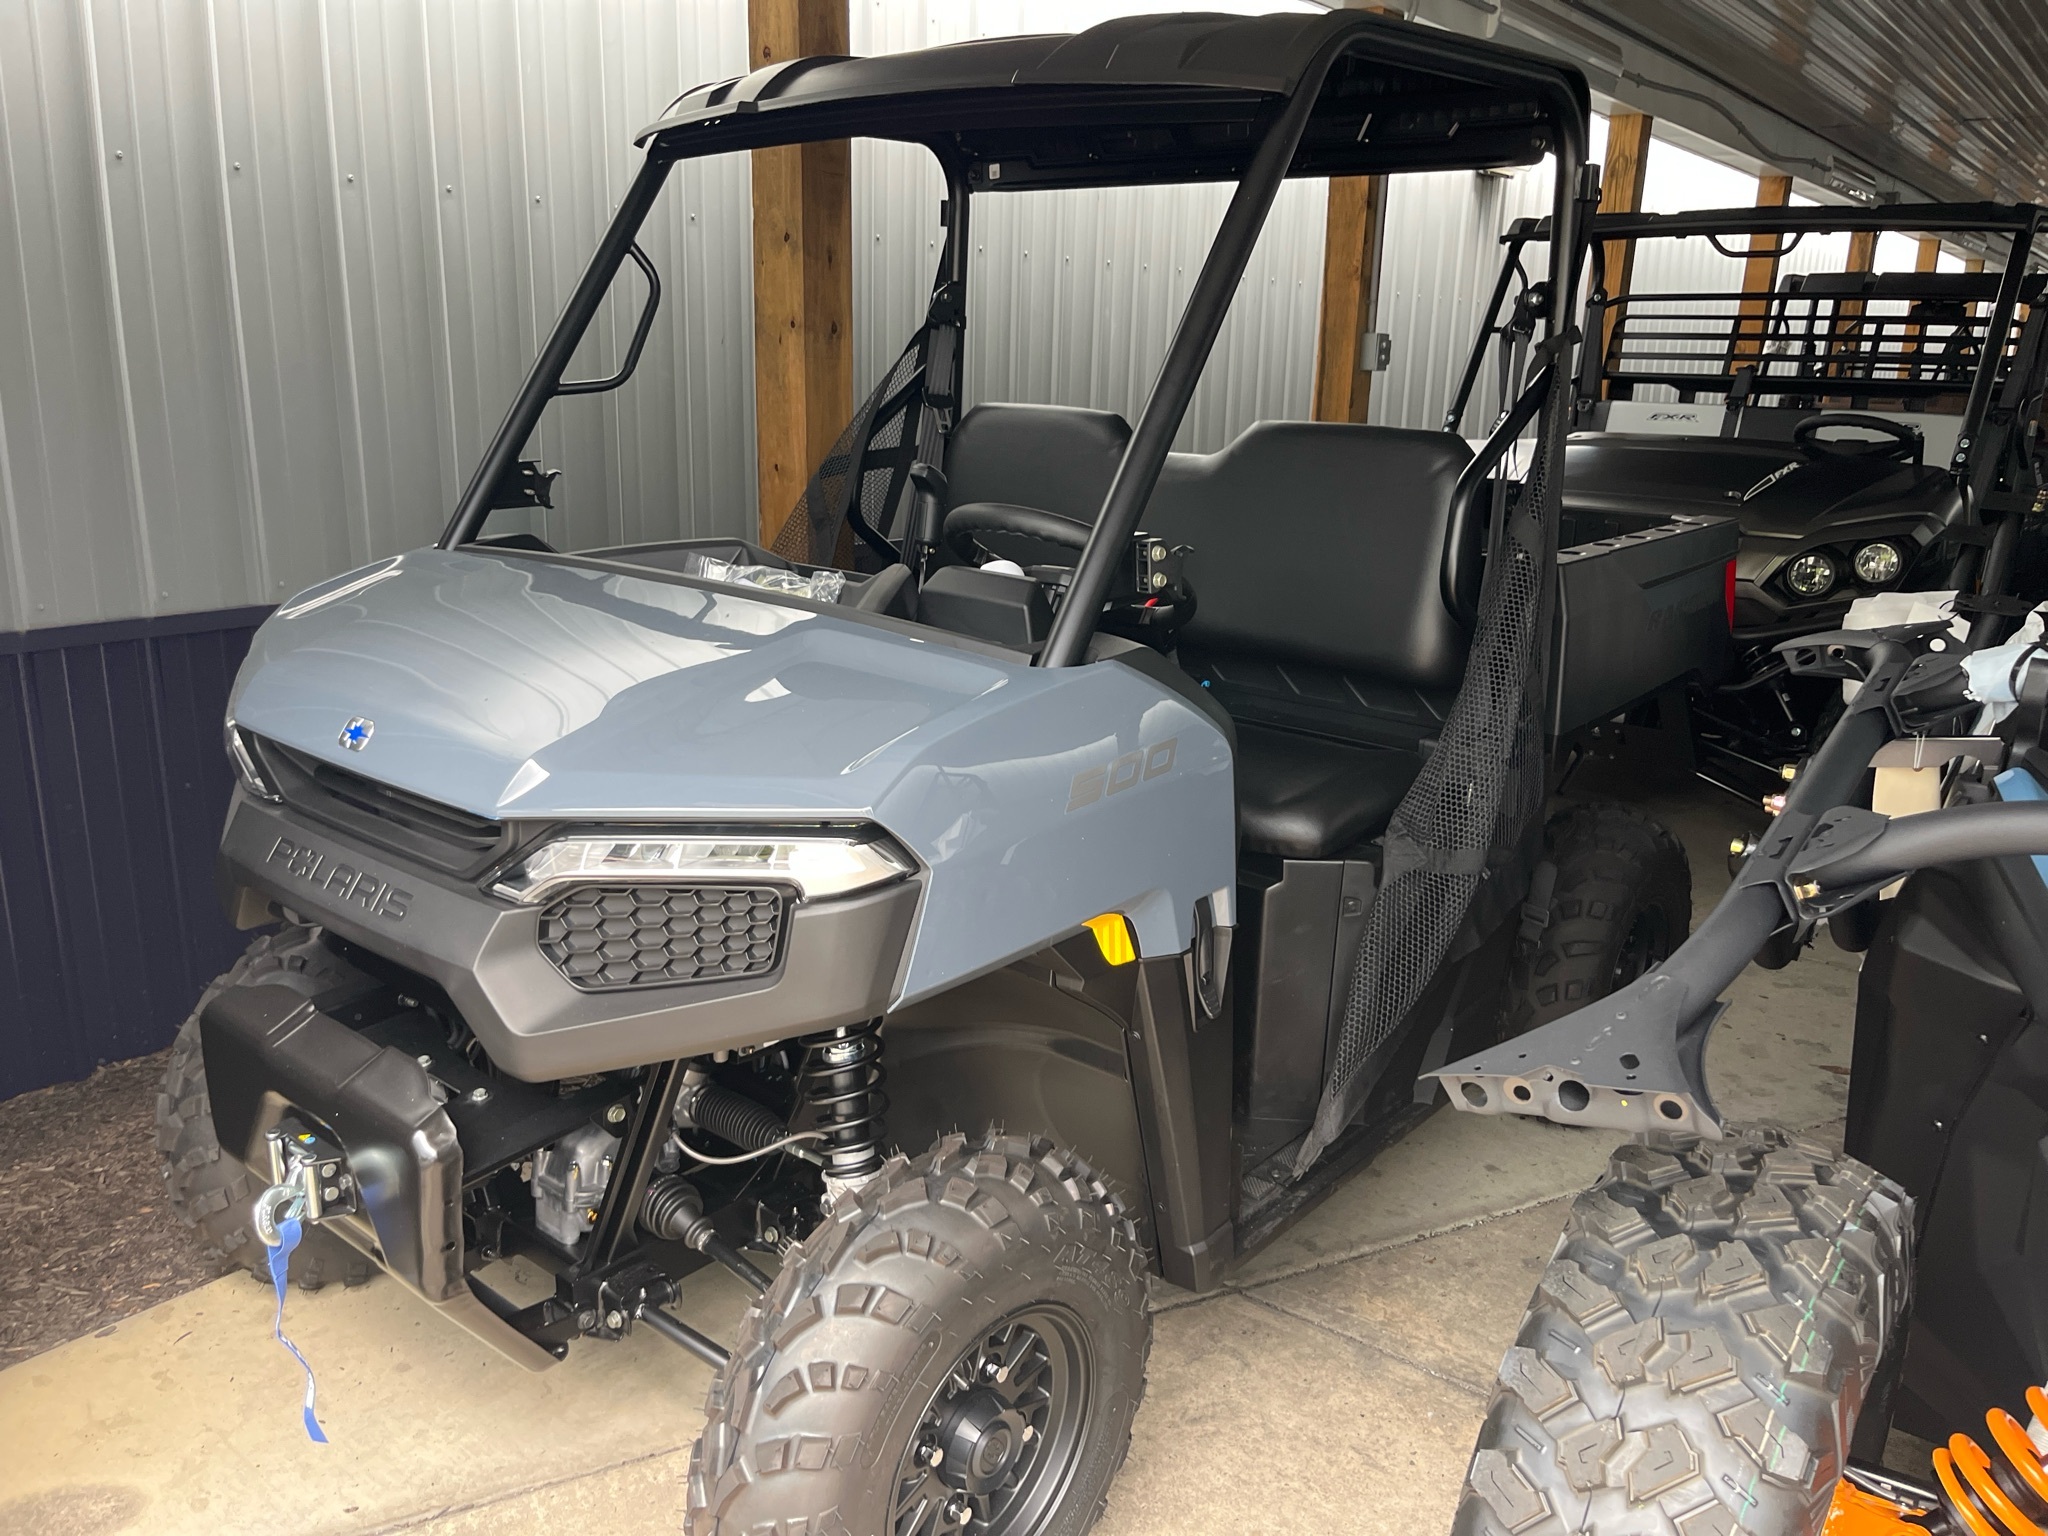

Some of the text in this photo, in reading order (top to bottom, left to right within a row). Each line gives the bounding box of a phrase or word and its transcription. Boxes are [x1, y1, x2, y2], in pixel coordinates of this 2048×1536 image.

[1774, 461, 1801, 480] FXR
[1064, 735, 1179, 815] 500
[265, 835, 415, 923] POLARIS
